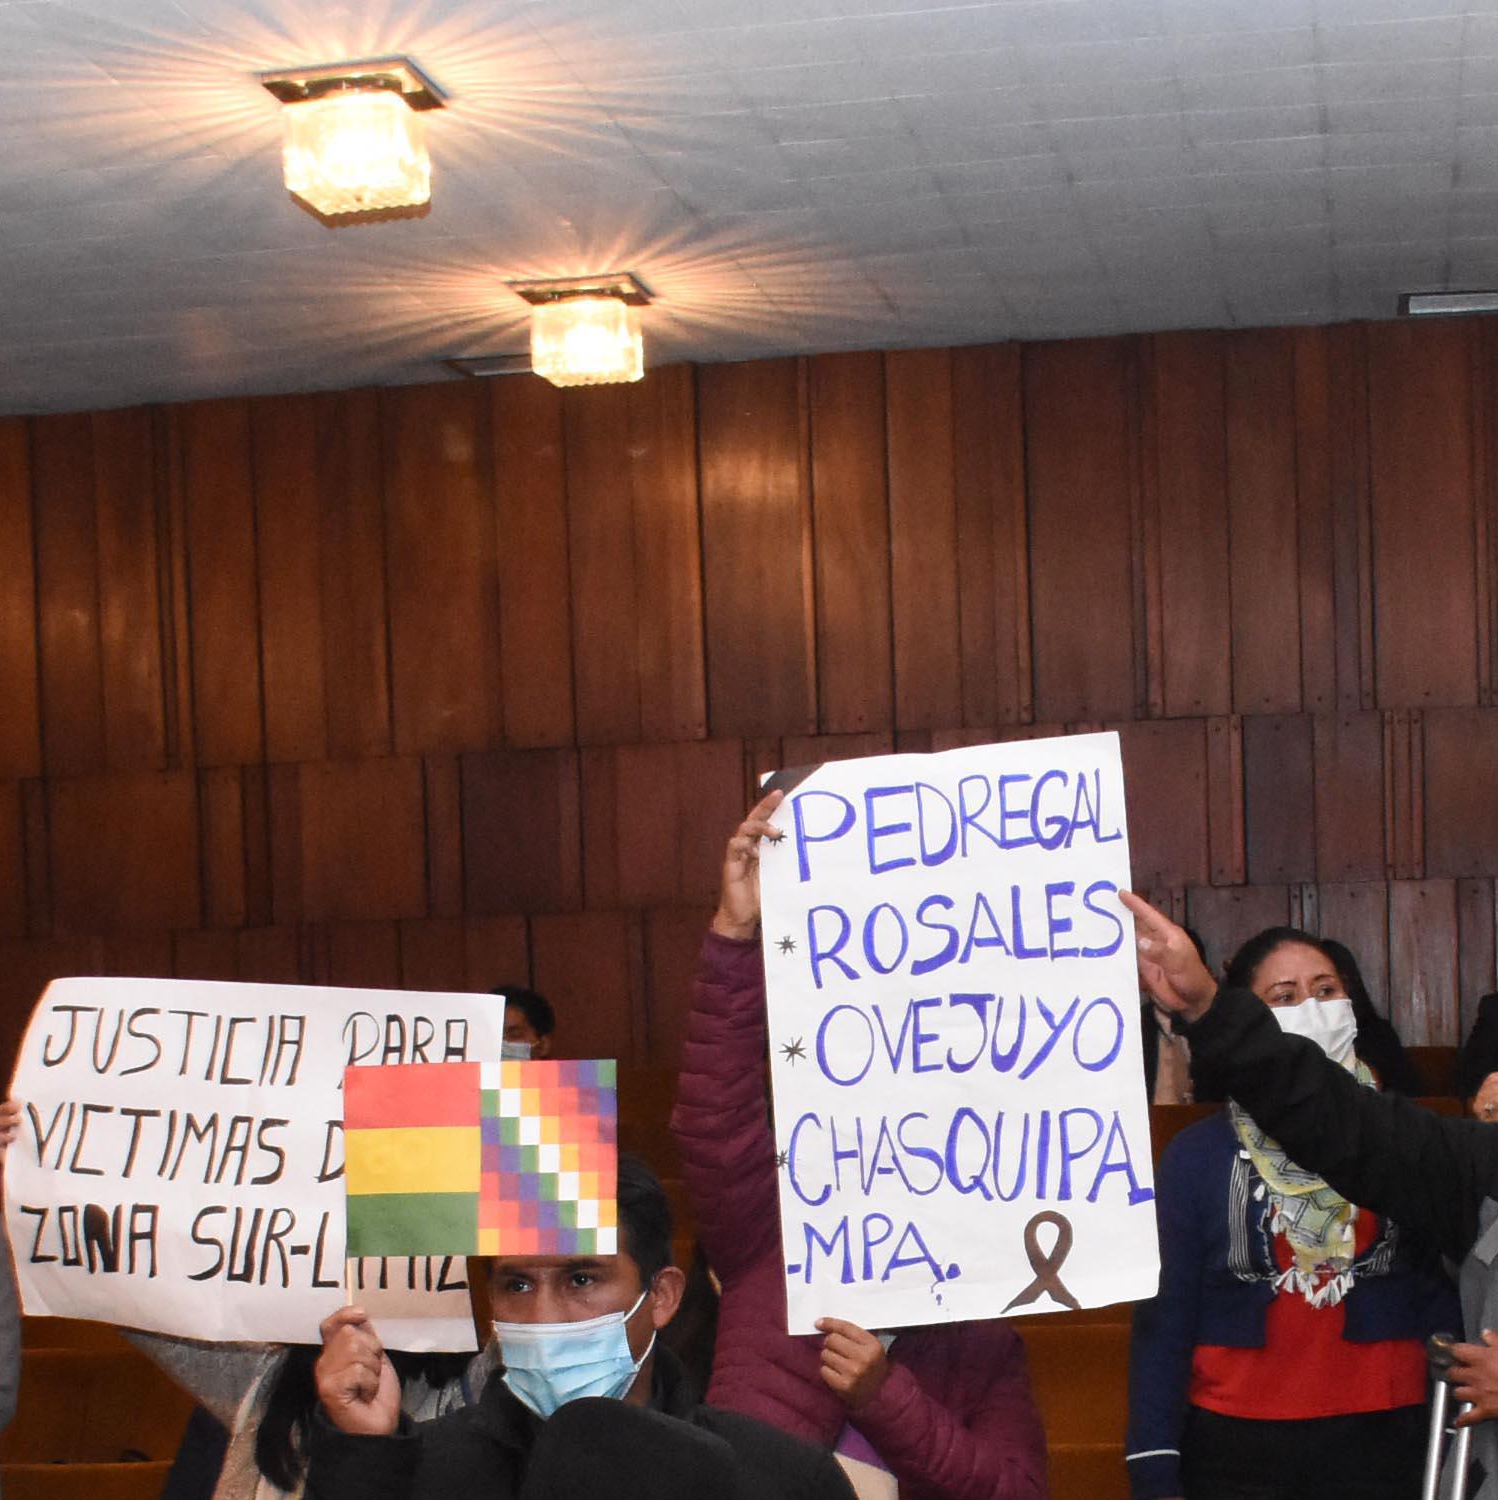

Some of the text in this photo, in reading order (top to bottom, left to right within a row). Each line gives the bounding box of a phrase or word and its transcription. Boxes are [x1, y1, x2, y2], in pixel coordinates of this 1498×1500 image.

[792, 769, 1123, 882] PEDREGAL
[806, 880, 1124, 989] ROSALES
[42, 1004, 469, 1087] JUSTICIA PARA
[816, 992, 1124, 1086] OVEJUYO
[27, 1103, 346, 1186] VICTIMAS D
[20, 1203, 158, 1279] ZONA
